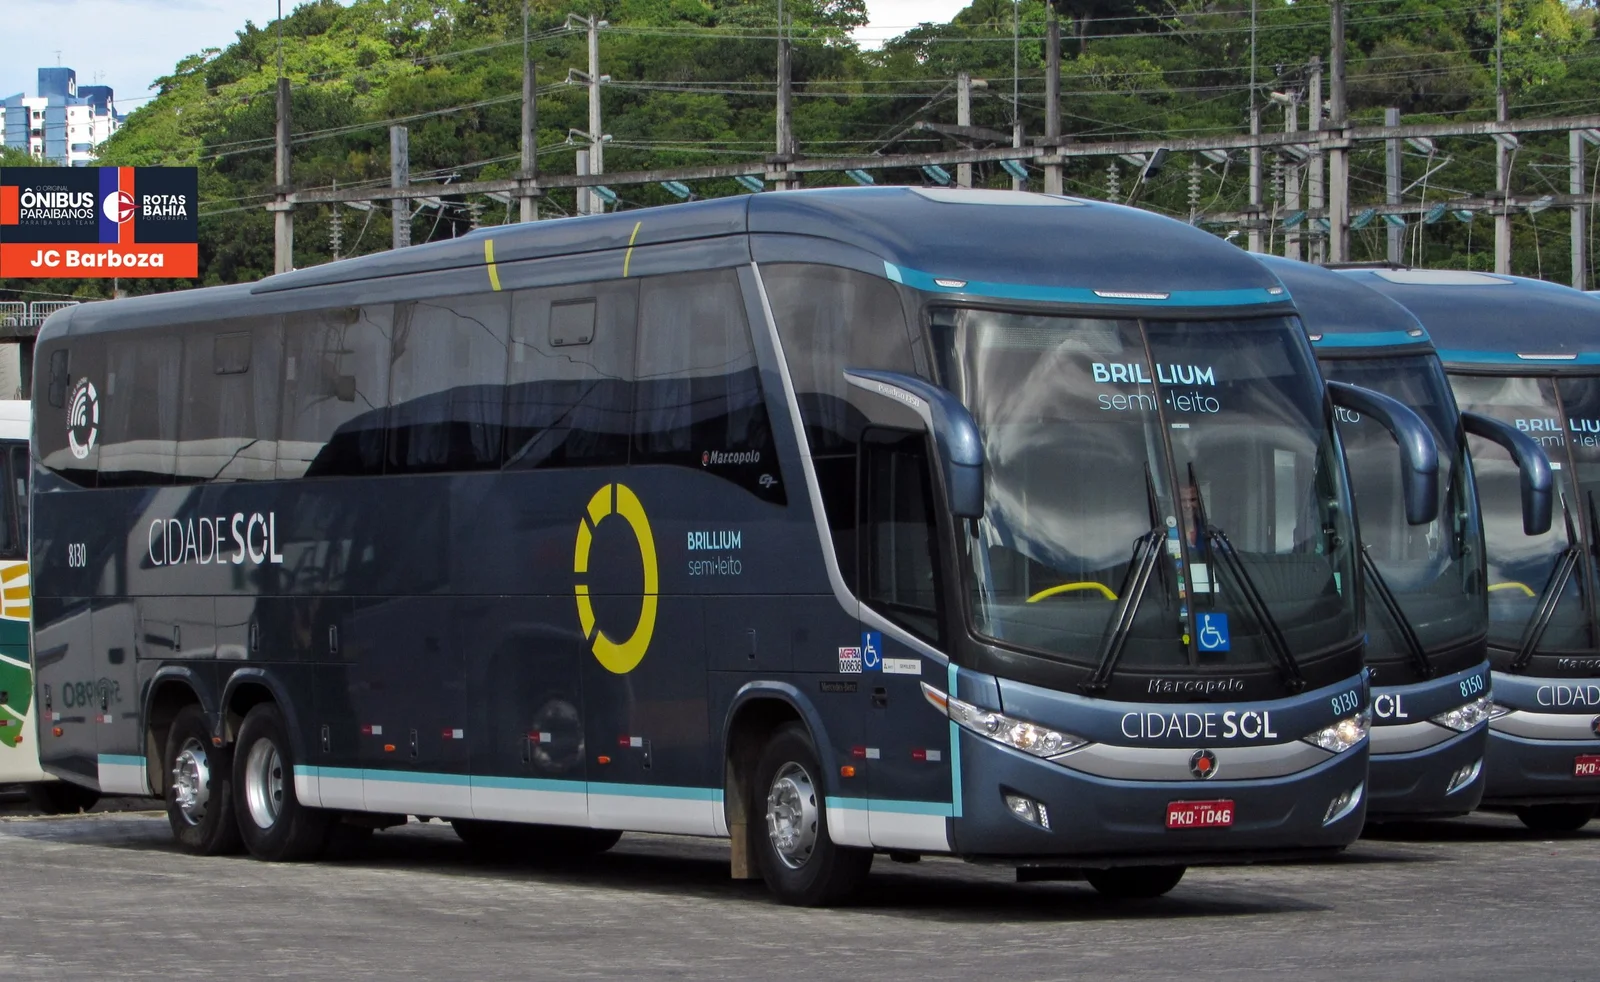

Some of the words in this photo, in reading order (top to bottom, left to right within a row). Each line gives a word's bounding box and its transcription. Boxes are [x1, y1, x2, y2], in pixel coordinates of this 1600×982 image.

[709, 449, 760, 466] Marcopolo
[148, 517, 227, 566] CIDADE
[231, 511, 283, 564] SOL
[687, 530, 742, 551] BRILLIUM
[68, 543, 86, 568] 8130
[839, 659, 862, 672] 008636
[1147, 678, 1245, 693] Marcopolo
[1459, 674, 1483, 697] 8150
[1331, 690, 1358, 716] 8130
[1121, 712, 1216, 739] CIDADE
[1222, 711, 1277, 738] SOL
